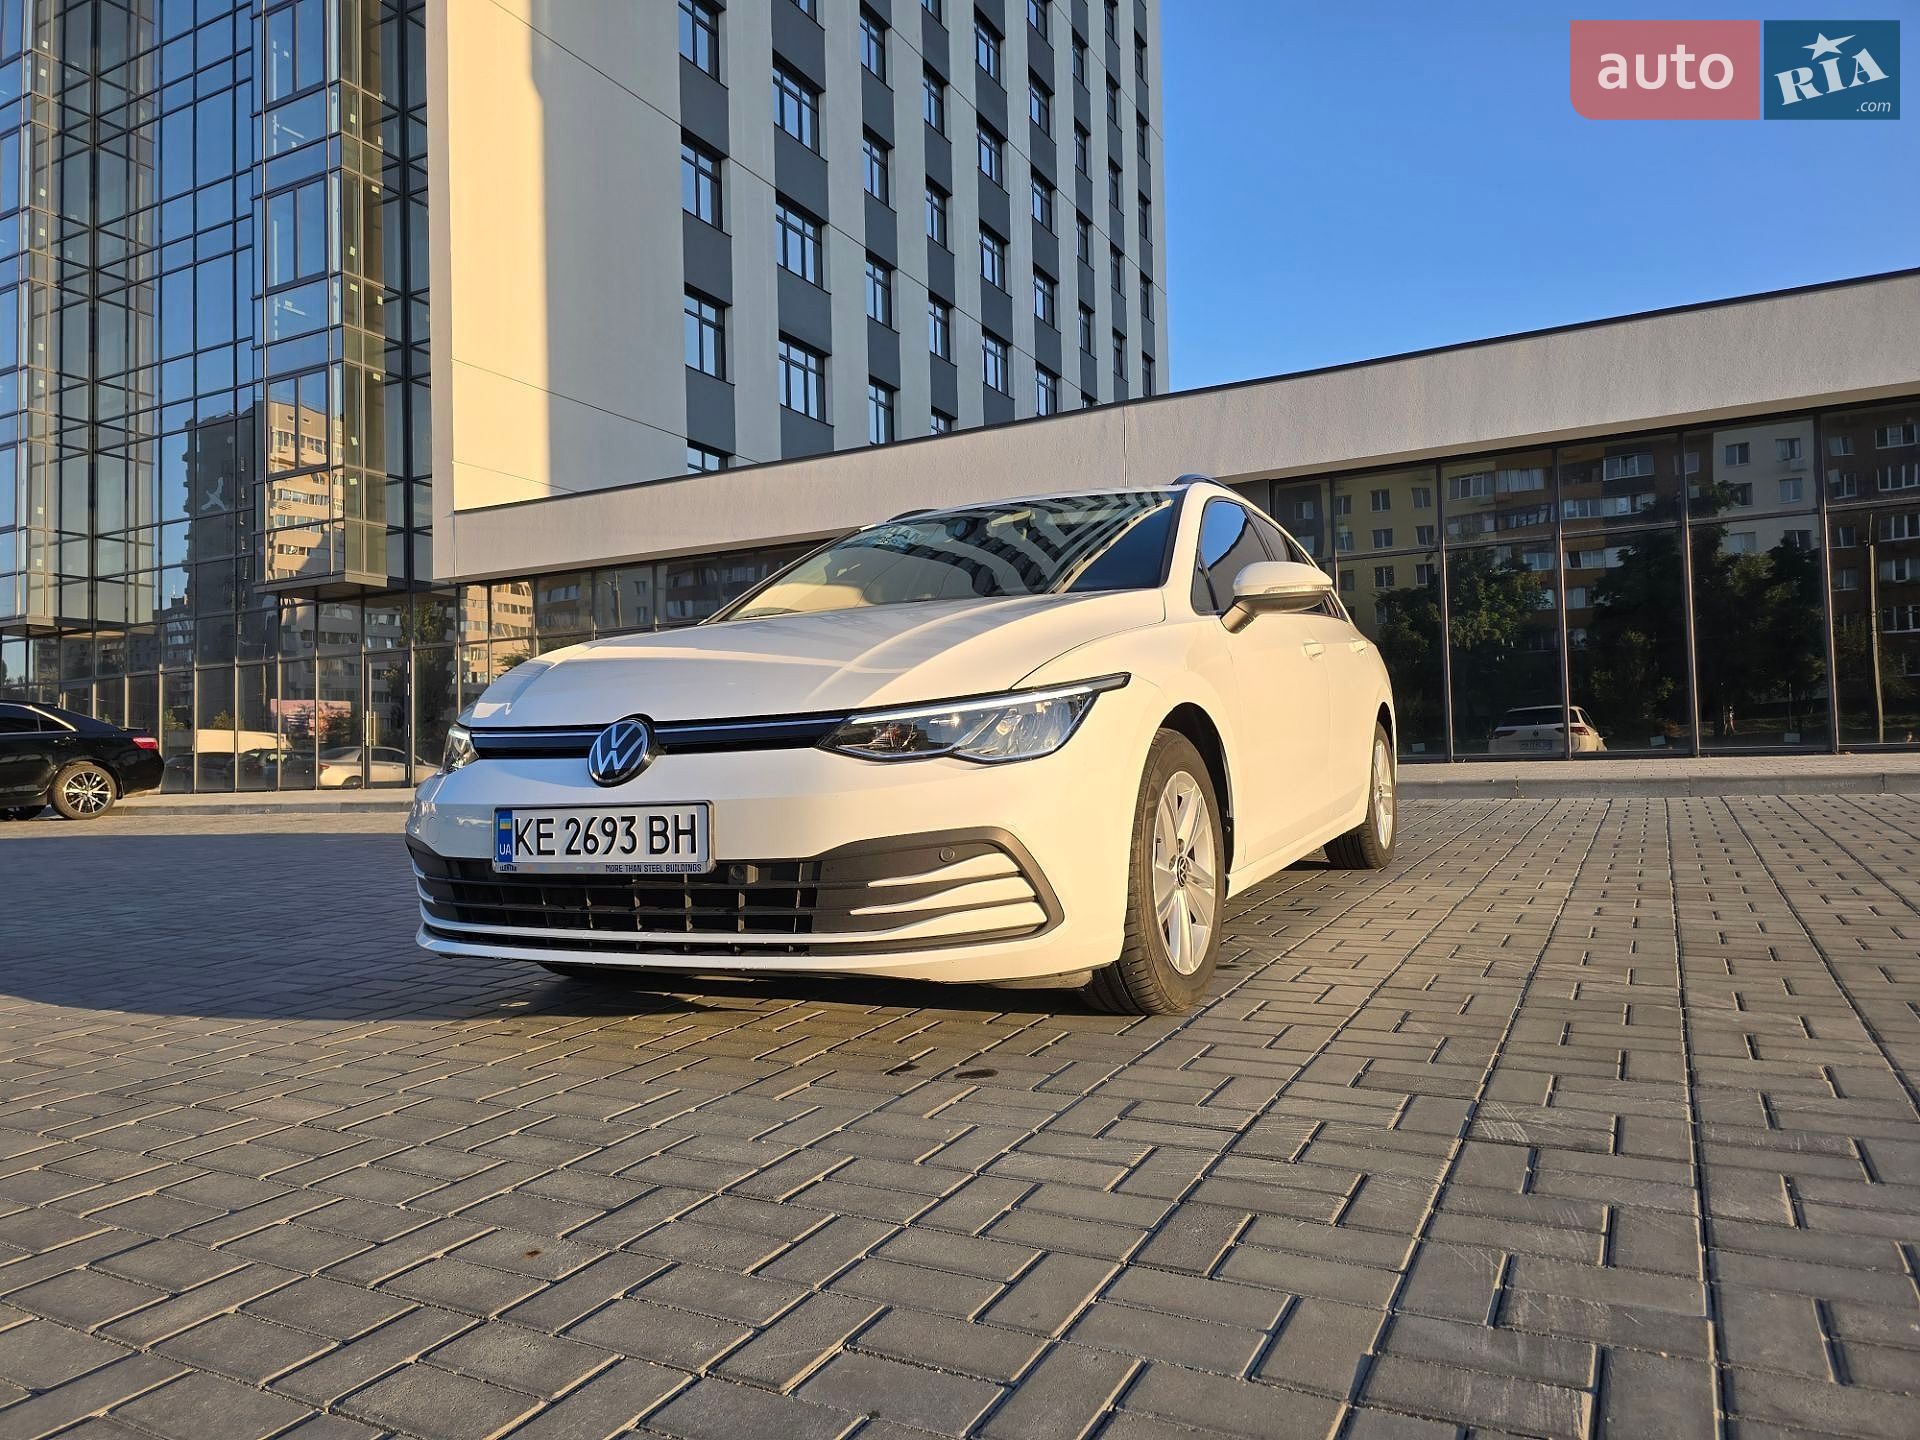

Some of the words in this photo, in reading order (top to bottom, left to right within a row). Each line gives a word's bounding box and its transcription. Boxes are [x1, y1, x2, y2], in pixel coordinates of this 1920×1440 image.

[589, 719, 647, 781] VW
[515, 817, 556, 856] KE
[564, 815, 637, 856] 2693
[649, 813, 697, 855] BH
[499, 843, 512, 856] UA
[605, 864, 623, 873] MORE
[625, 864, 642, 873] THAN
[643, 864, 664, 873] STEEL
[665, 863, 702, 873] BUILDINGS
